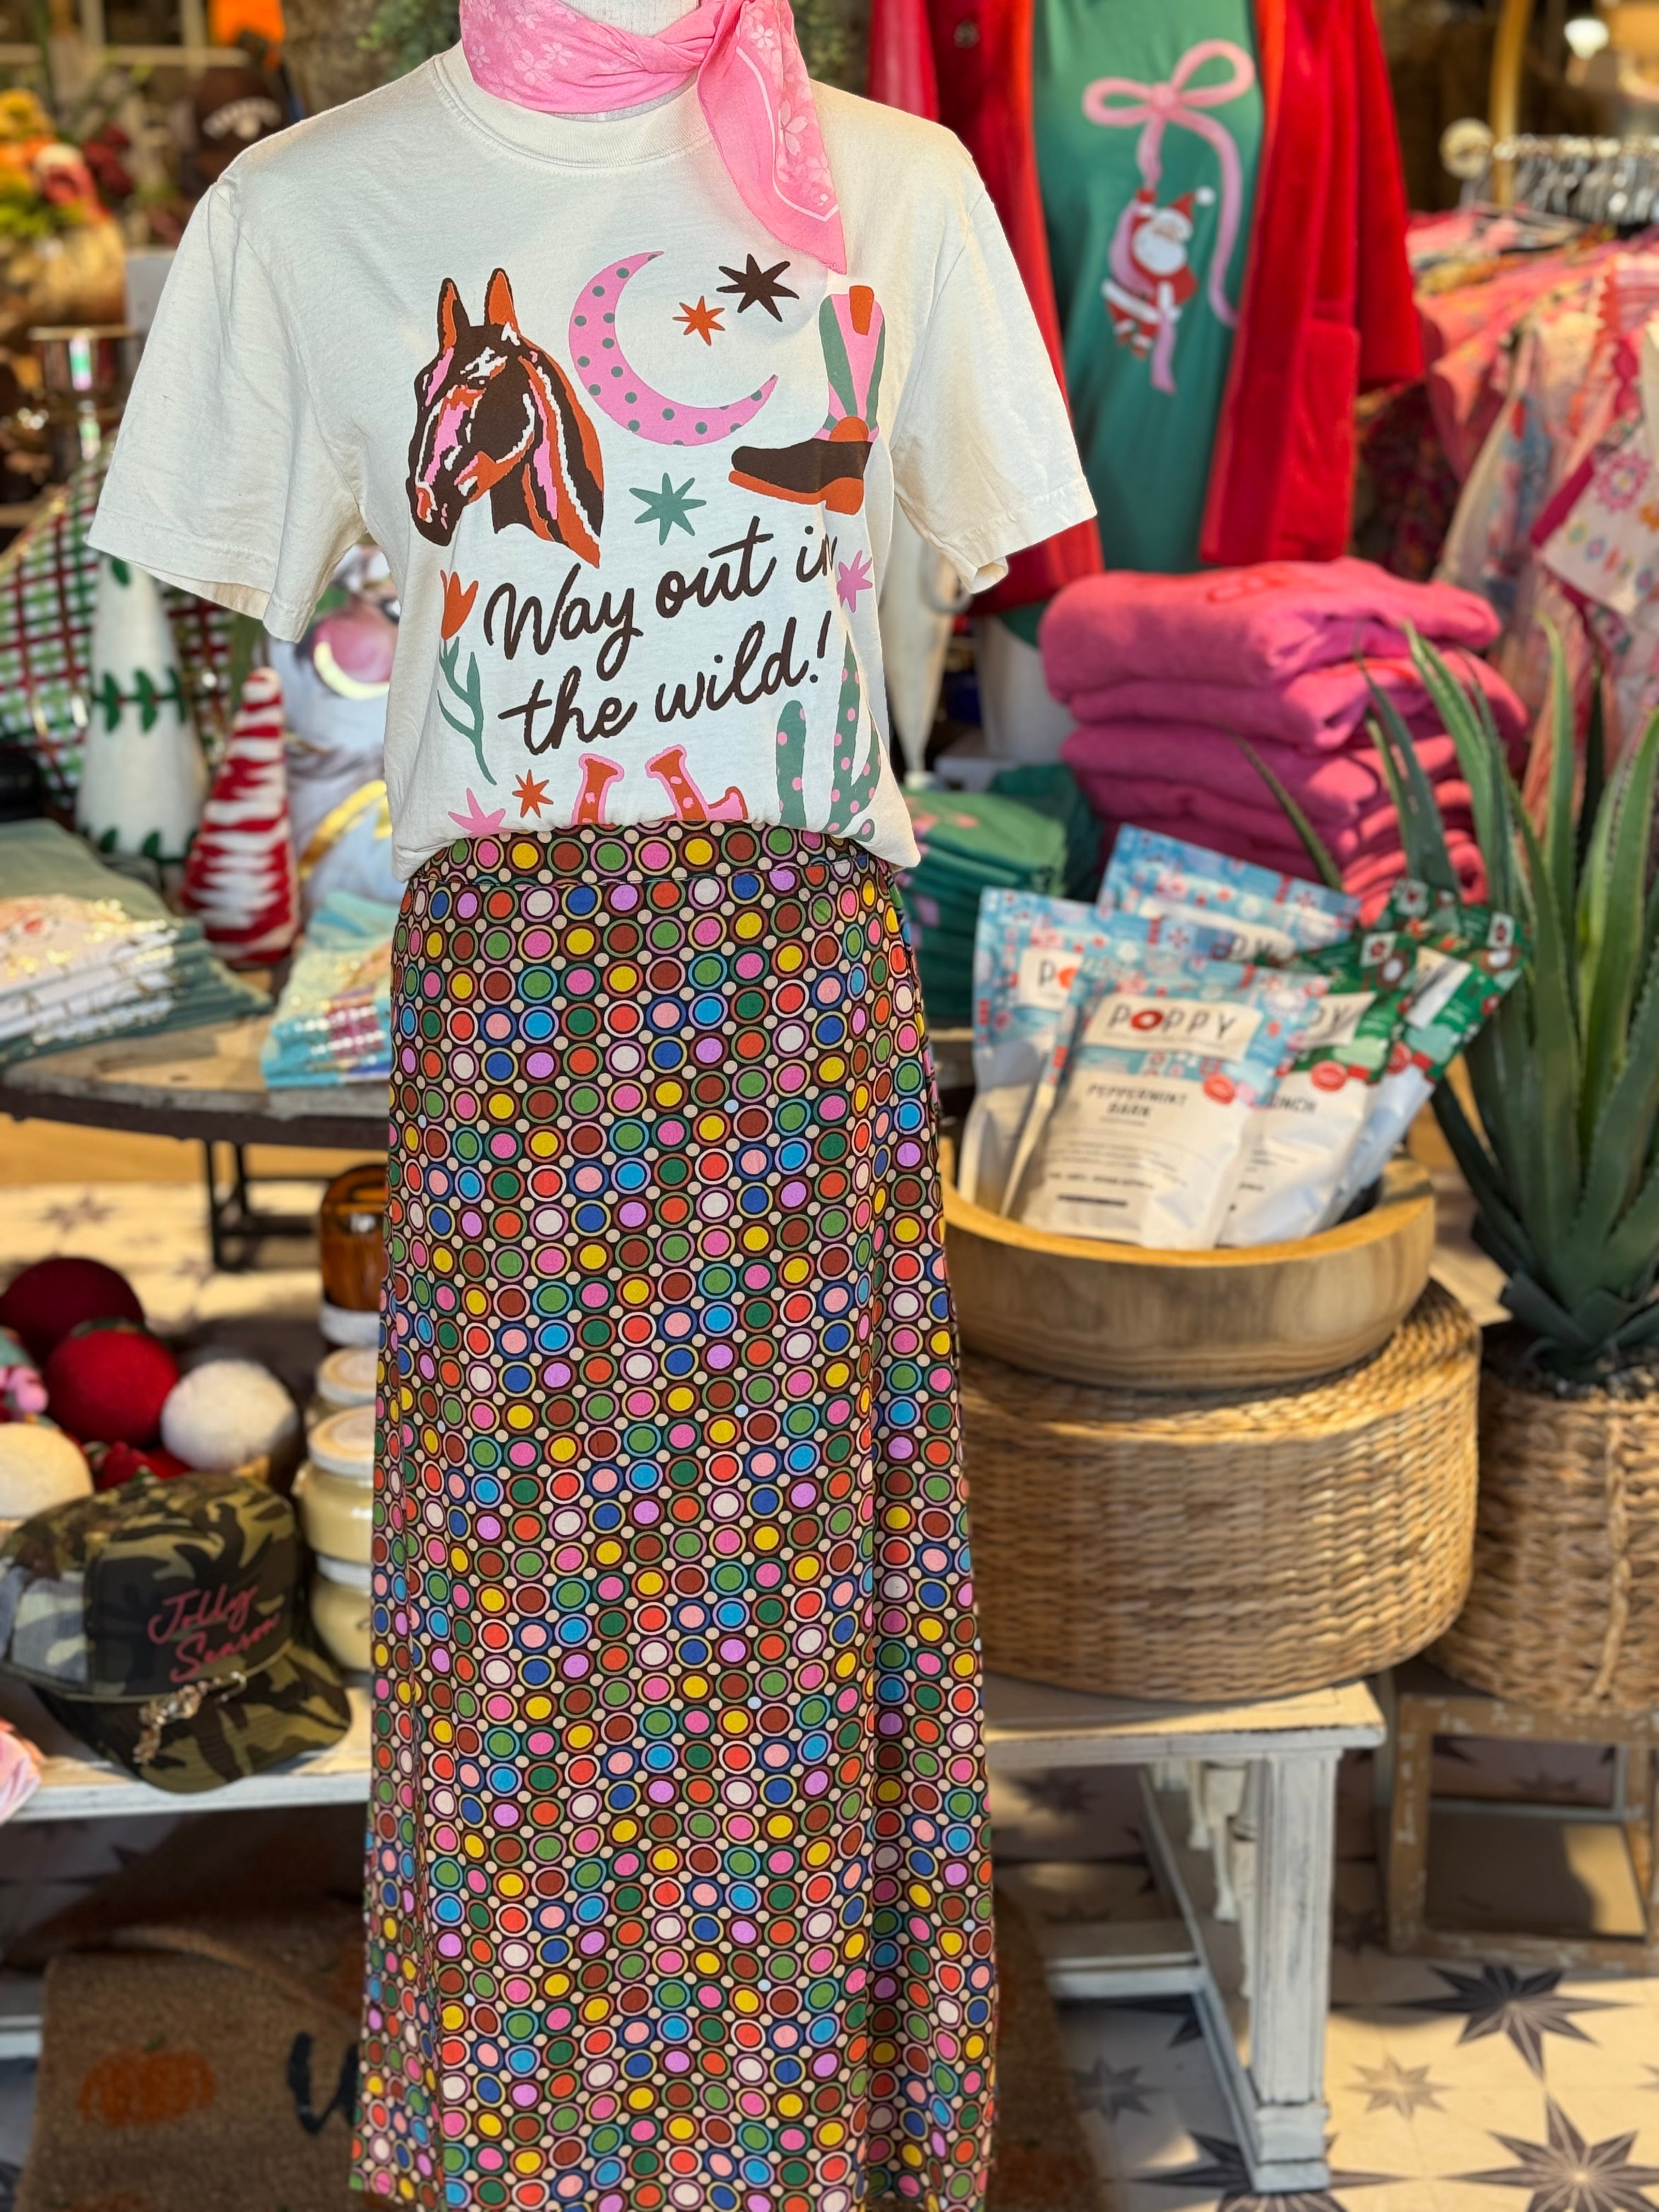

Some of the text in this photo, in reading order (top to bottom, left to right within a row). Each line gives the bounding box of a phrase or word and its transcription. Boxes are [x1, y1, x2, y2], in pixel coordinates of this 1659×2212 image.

[484, 563, 644, 681] Way
[655, 516, 777, 619] out
[498, 610, 831, 755] the wild!
[1108, 1004, 1236, 1039] POPPY
[169, 1612, 281, 1683] Season
